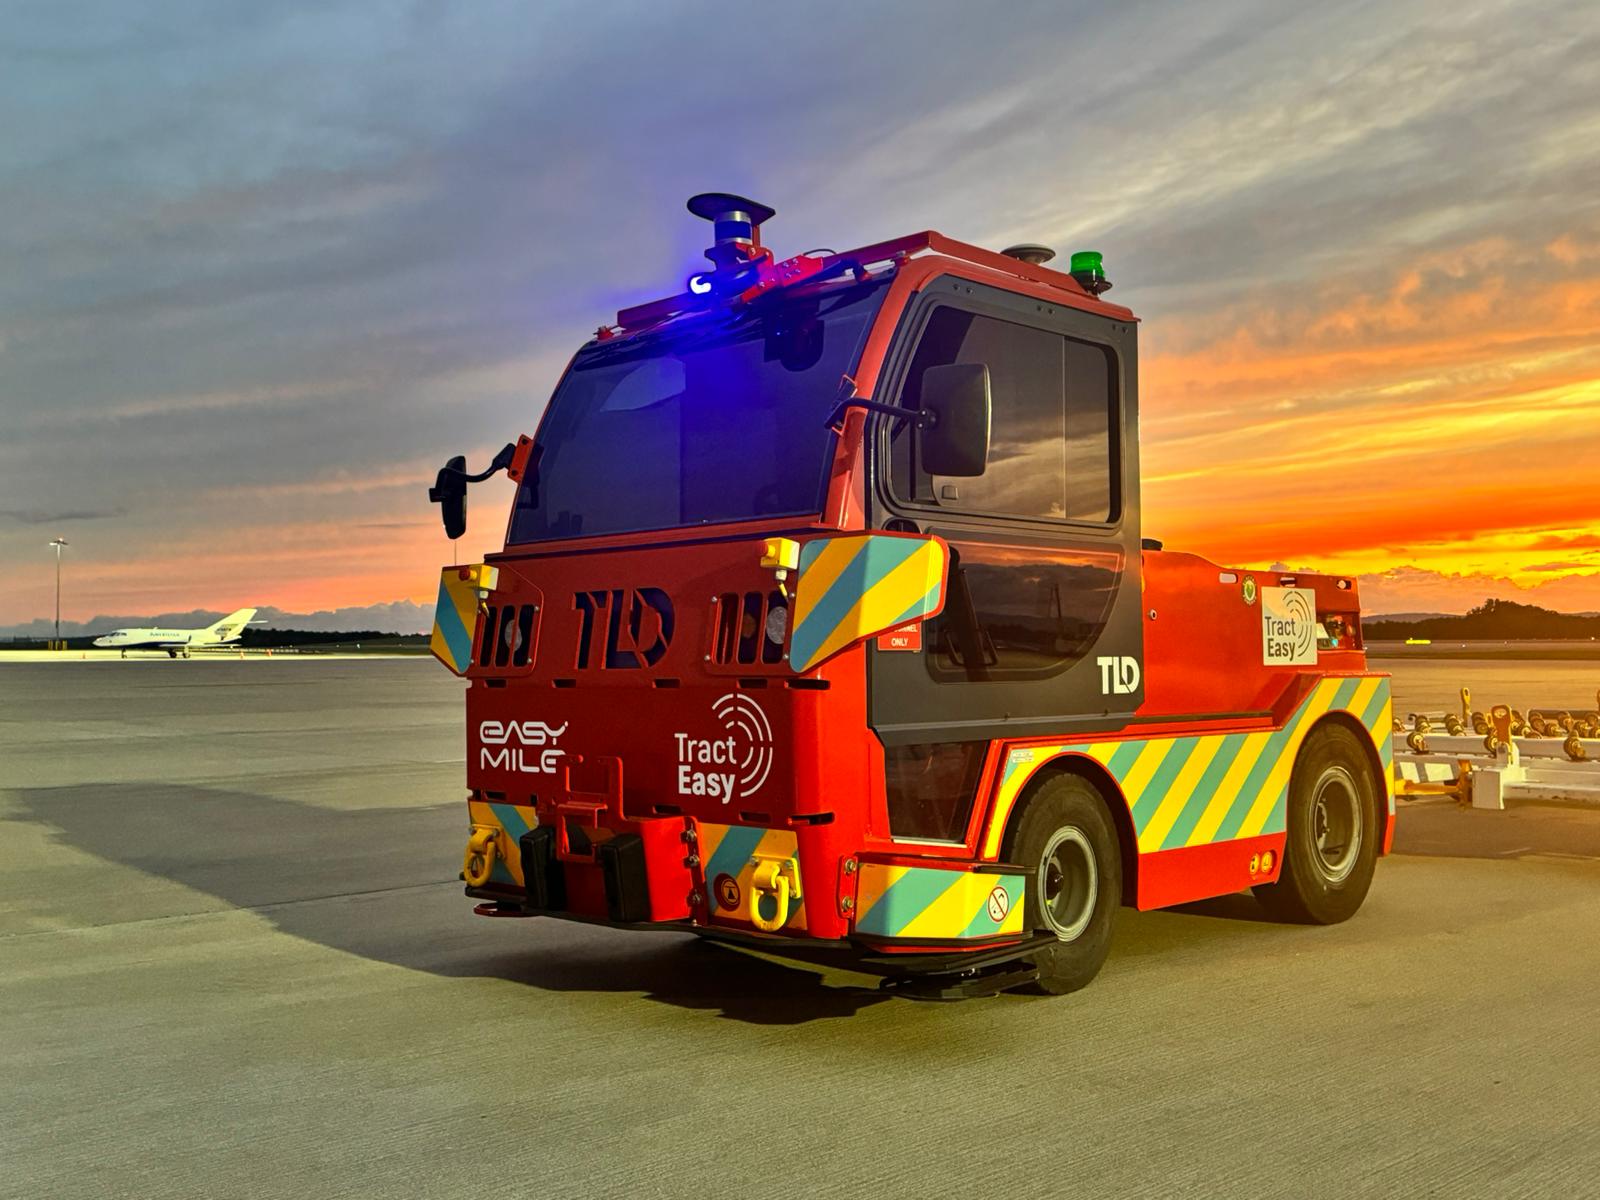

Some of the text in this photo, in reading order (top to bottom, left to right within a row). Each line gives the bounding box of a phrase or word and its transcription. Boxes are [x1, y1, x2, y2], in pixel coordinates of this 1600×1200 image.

[572, 587, 675, 669] TLD
[1264, 616, 1296, 636] Tract
[891, 637, 908, 647] ONLY
[1267, 638, 1296, 662] Easy
[1097, 656, 1140, 694] TLD
[674, 733, 737, 764] Tract
[678, 765, 736, 804] Easy
